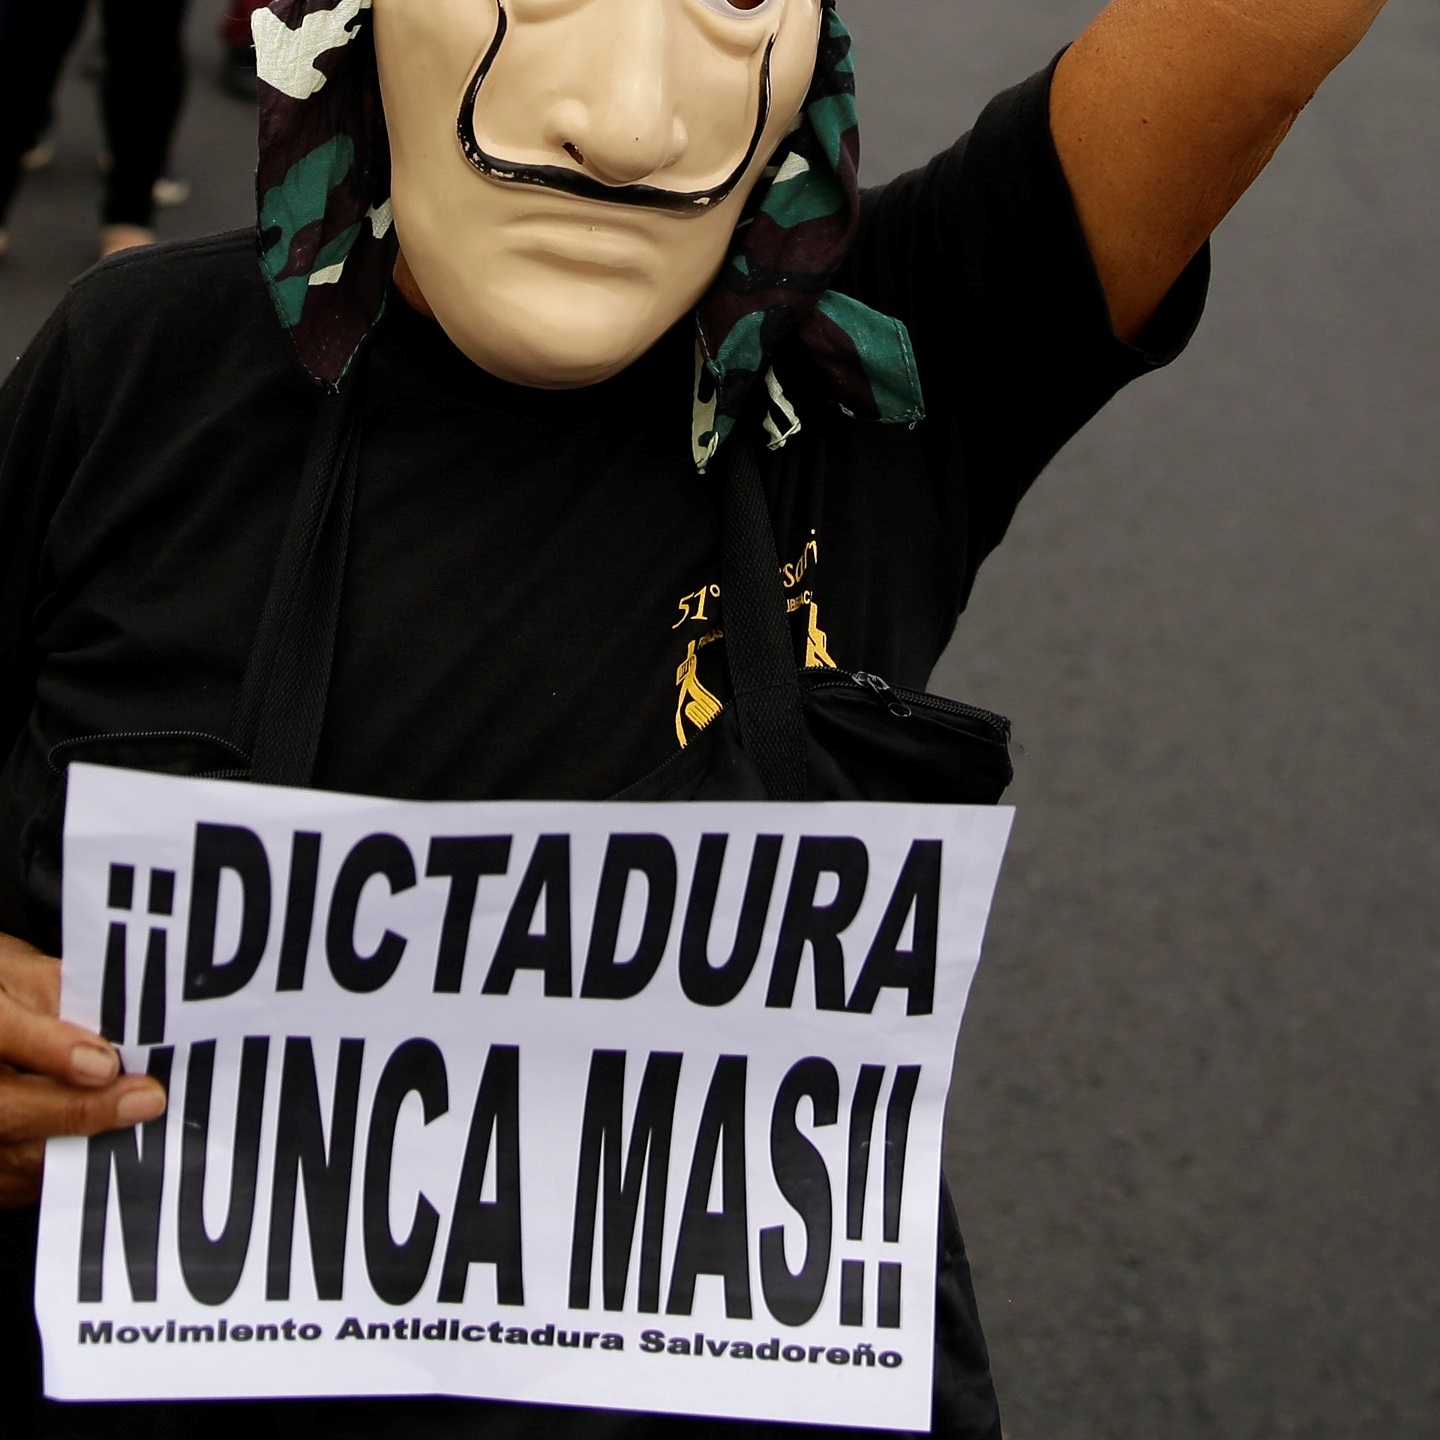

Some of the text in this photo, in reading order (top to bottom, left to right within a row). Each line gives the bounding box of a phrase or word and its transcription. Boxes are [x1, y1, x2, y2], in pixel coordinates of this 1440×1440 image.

[99, 821, 943, 1045] ¡¡DICTADURA
[77, 1035, 921, 1329] NUNCA MAS!!
[77, 1315, 903, 1370] Movimiento Antidictadura Salvadoreño
